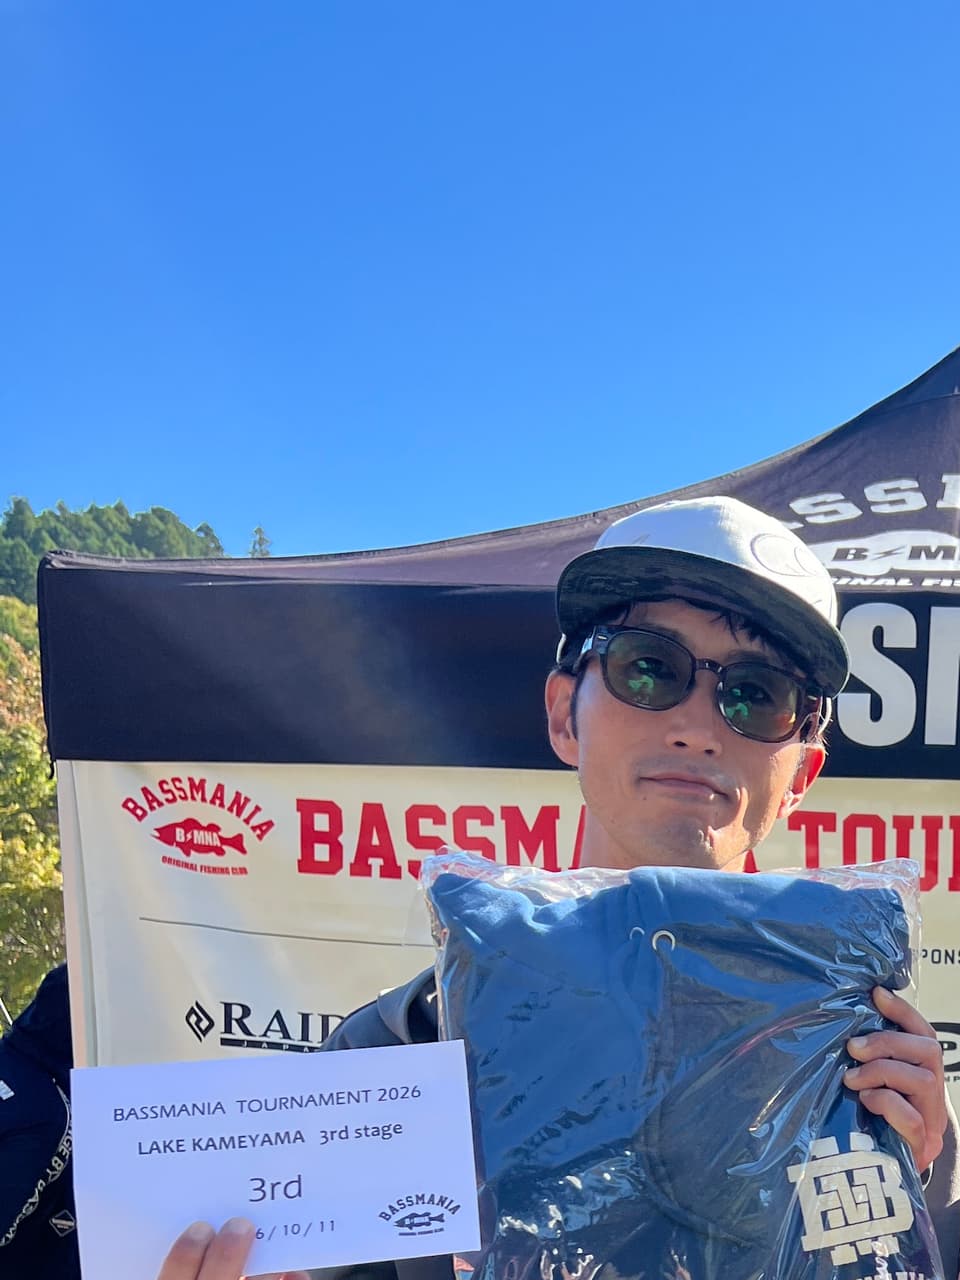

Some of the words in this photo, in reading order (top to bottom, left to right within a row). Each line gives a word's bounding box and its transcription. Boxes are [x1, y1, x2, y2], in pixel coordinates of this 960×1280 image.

[121, 776, 275, 841] BASSMANIA
[296, 798, 586, 881] BASSM
[161, 855, 198, 872] ORIGINAL
[199, 864, 230, 875] FISHING
[242, 1040, 310, 1053] JAPA
[113, 1101, 226, 1122] BASSMANIA
[236, 1089, 372, 1114] TOURNAMENT
[377, 1085, 422, 1102] 2026
[138, 1138, 187, 1155] LAKE
[191, 1130, 306, 1152] KAMEYAMA
[319, 1125, 350, 1145] 3rd
[354, 1122, 404, 1140] stage
[249, 1174, 303, 1203] 3rd
[378, 1193, 462, 1221] BASSMANIA
